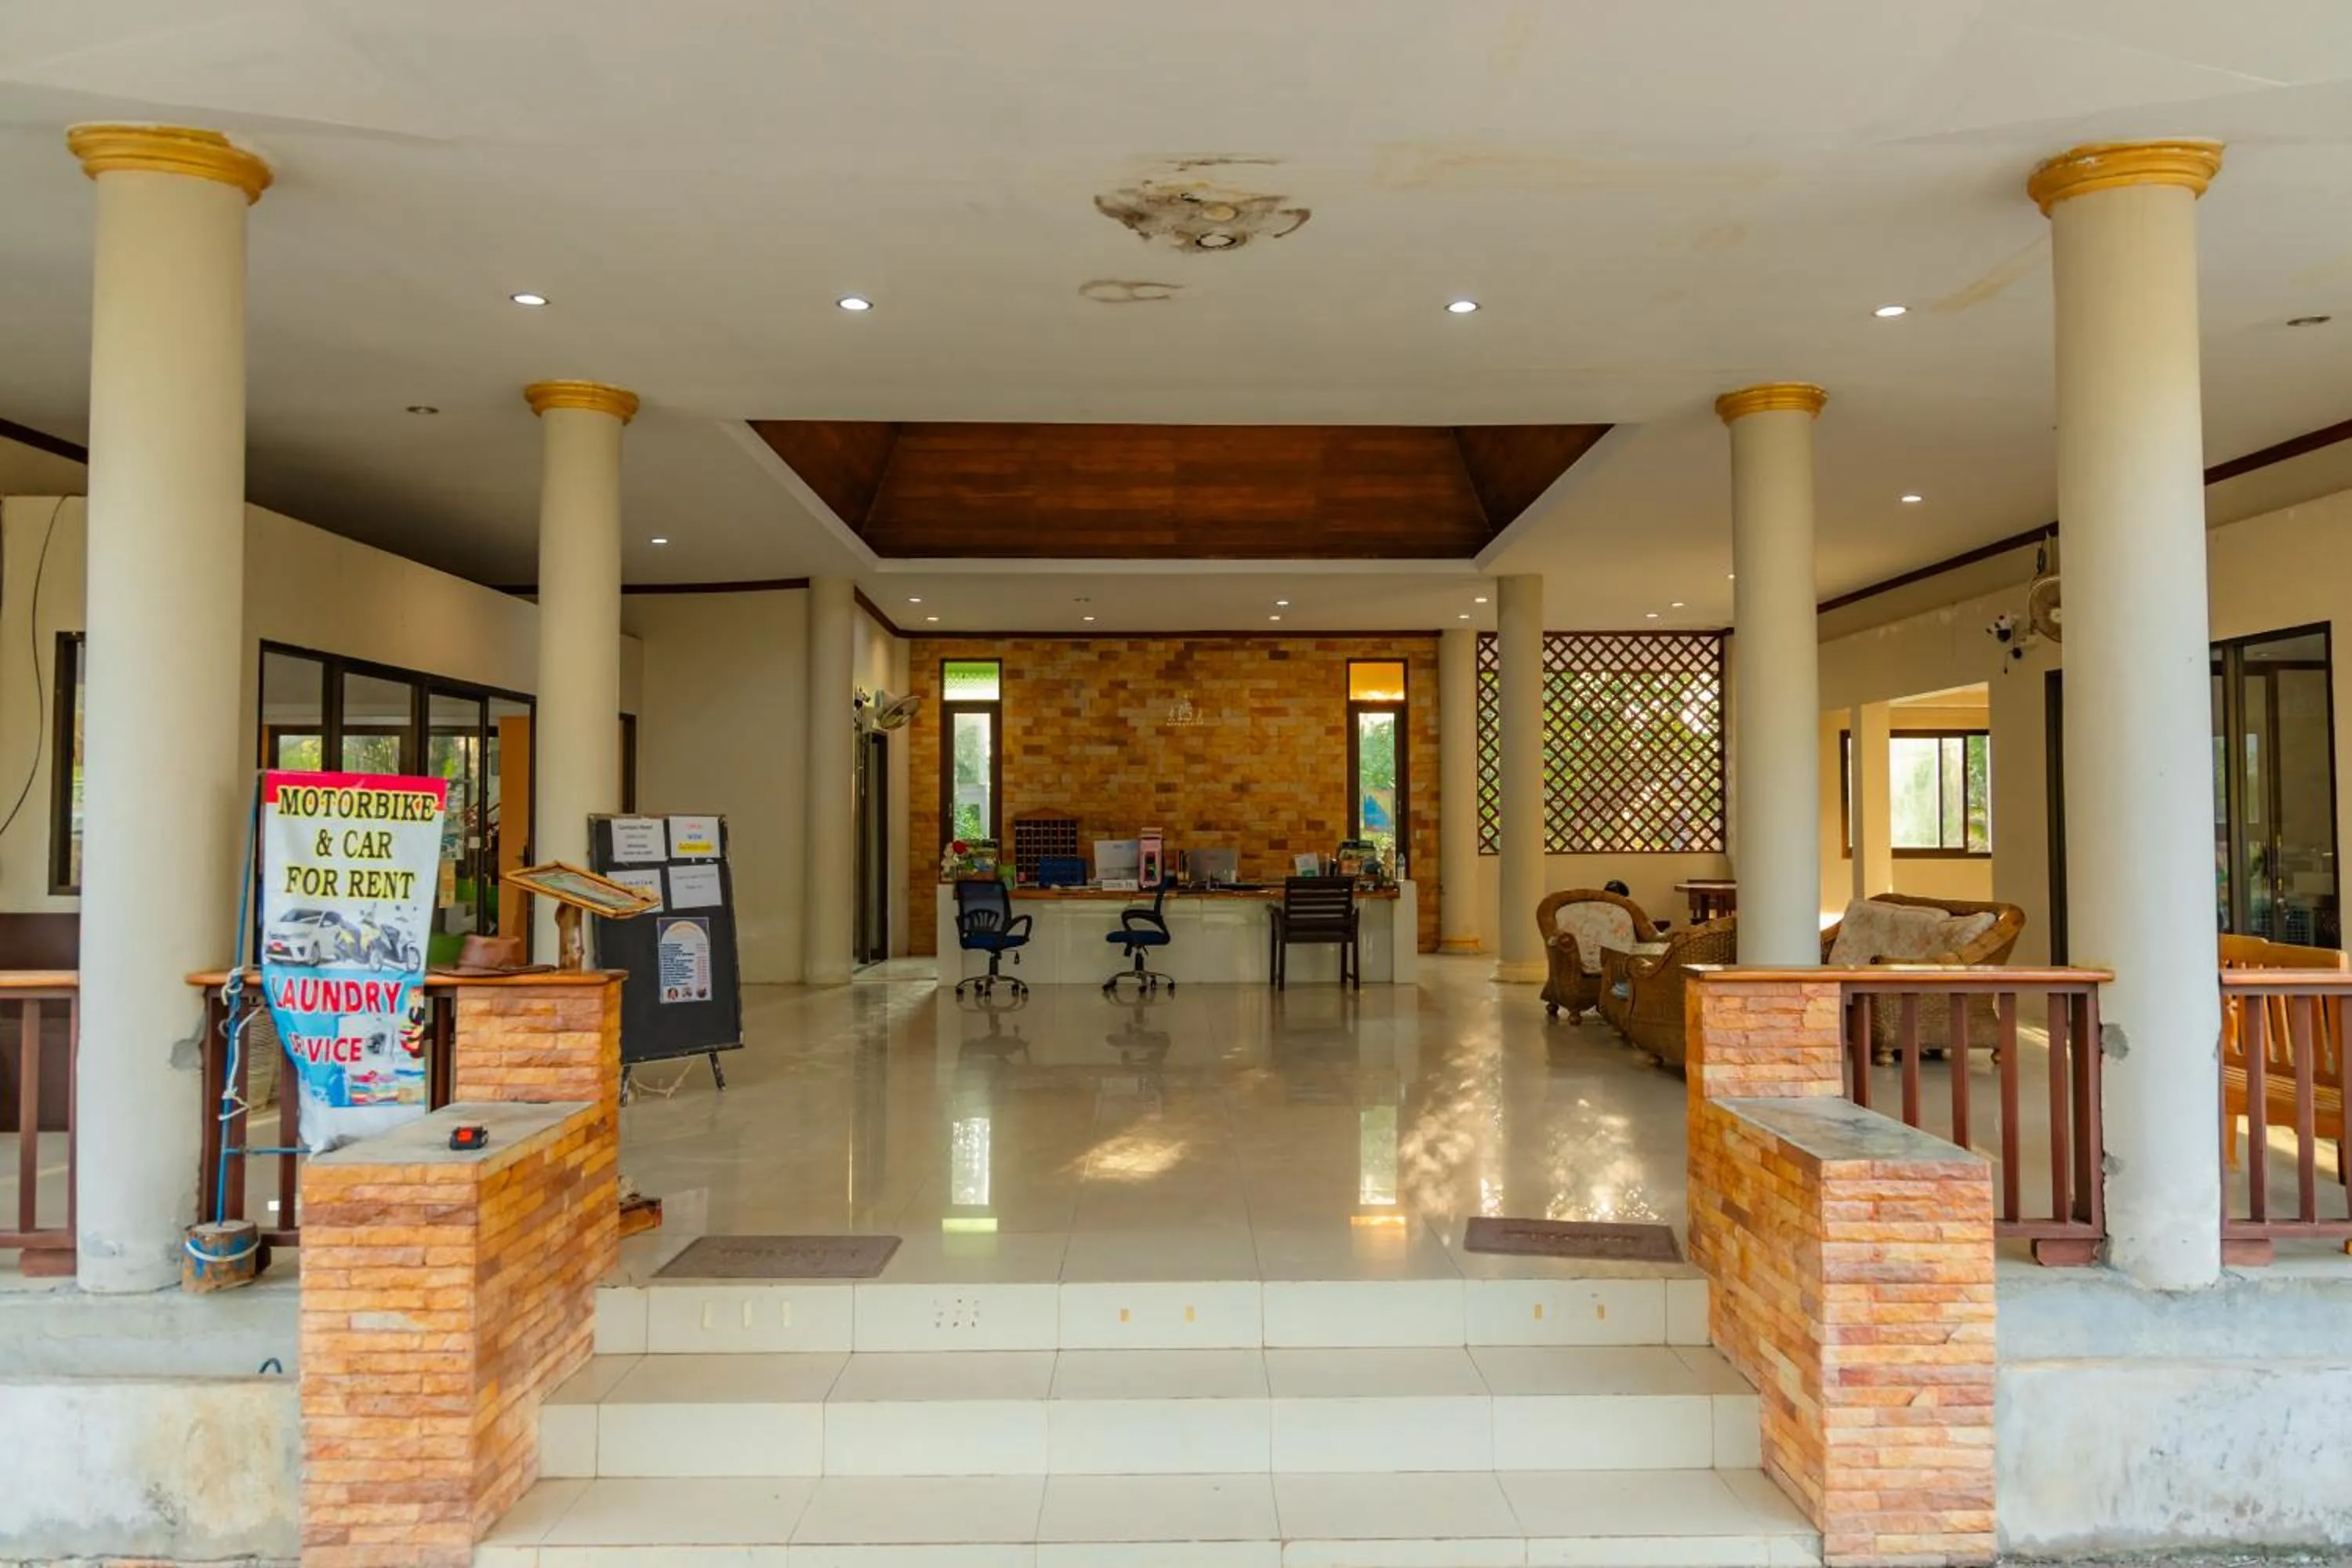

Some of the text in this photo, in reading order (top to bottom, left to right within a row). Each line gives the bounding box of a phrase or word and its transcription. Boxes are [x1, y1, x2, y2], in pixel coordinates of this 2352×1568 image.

[278, 787, 435, 821] MOTORBIKE
[316, 829, 393, 858] & CAR
[285, 866, 415, 899] FOR RENT
